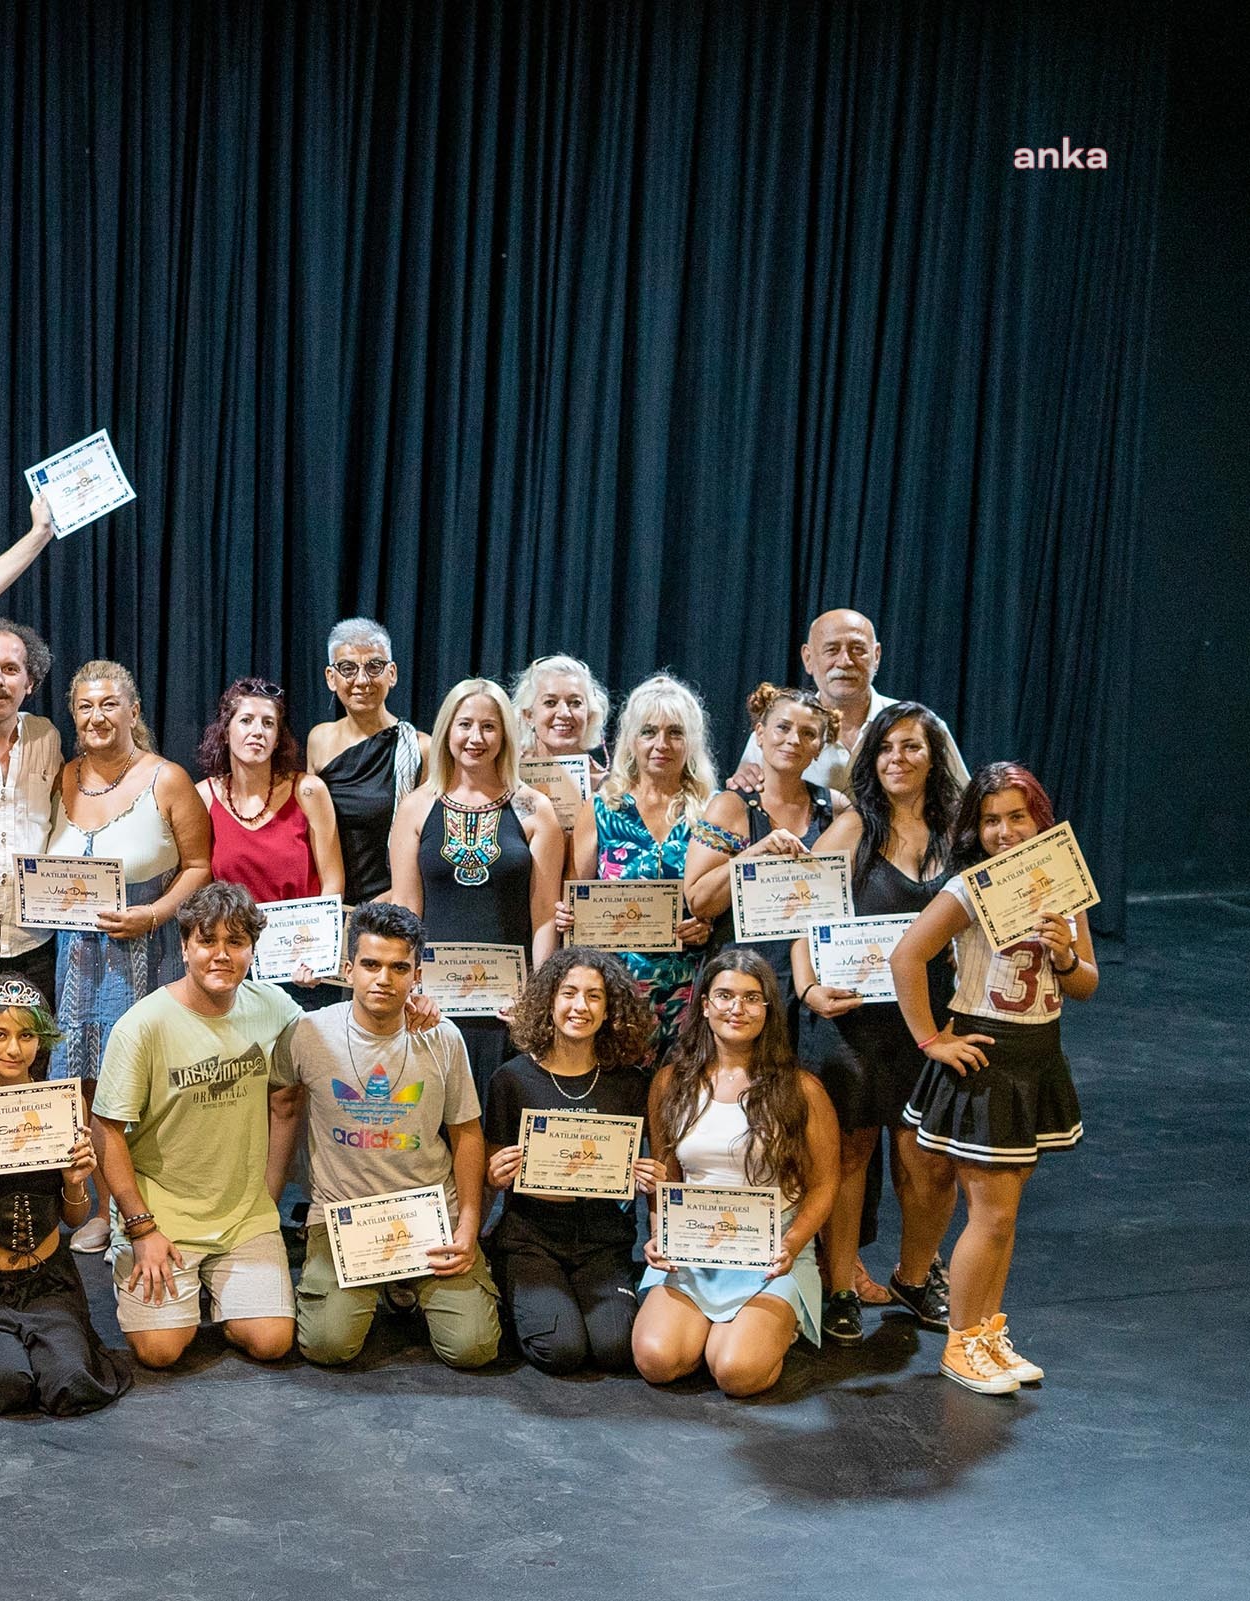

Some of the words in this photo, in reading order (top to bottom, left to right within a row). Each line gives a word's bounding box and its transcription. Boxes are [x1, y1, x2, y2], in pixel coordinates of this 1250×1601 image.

[332, 1127, 420, 1151] adidas
[549, 1131, 579, 1140] KATILIM
[686, 1204, 717, 1212] KATILIM
[356, 1216, 386, 1227] KATILIM
